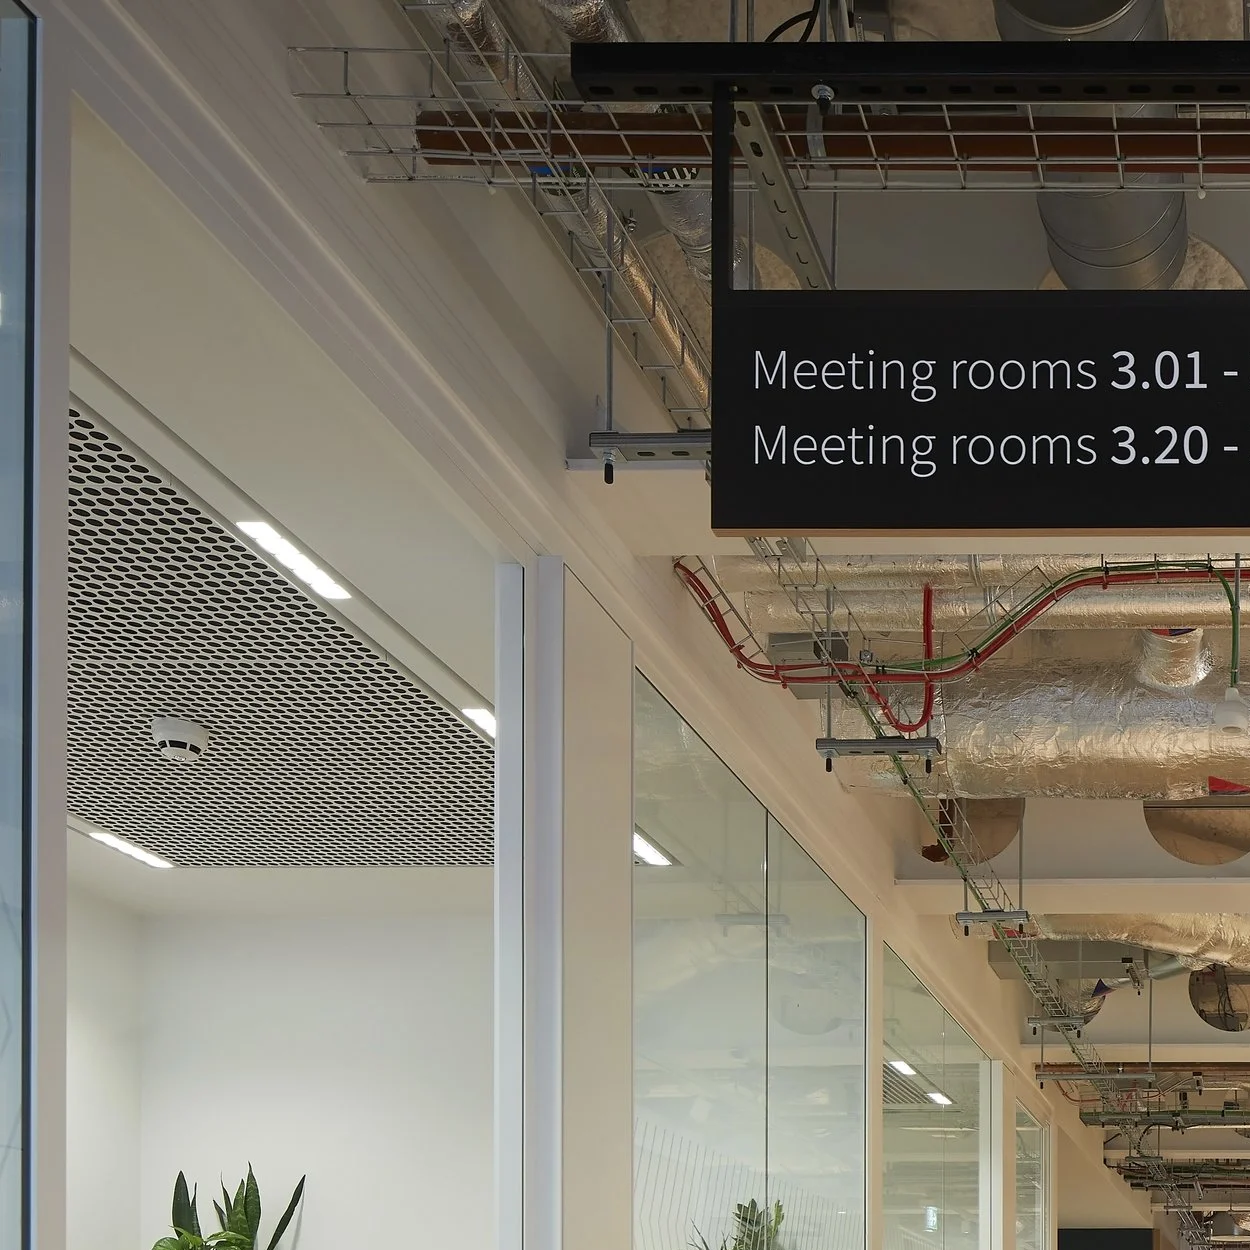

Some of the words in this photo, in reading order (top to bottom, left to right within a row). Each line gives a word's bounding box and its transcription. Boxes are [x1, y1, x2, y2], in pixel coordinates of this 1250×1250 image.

[754, 349, 937, 403] Meeting
[952, 358, 1097, 390] rooms
[1110, 350, 1208, 390] 3.01
[754, 424, 937, 478] Meeting
[952, 433, 1097, 465] rooms
[1110, 425, 1208, 465] 3.20
